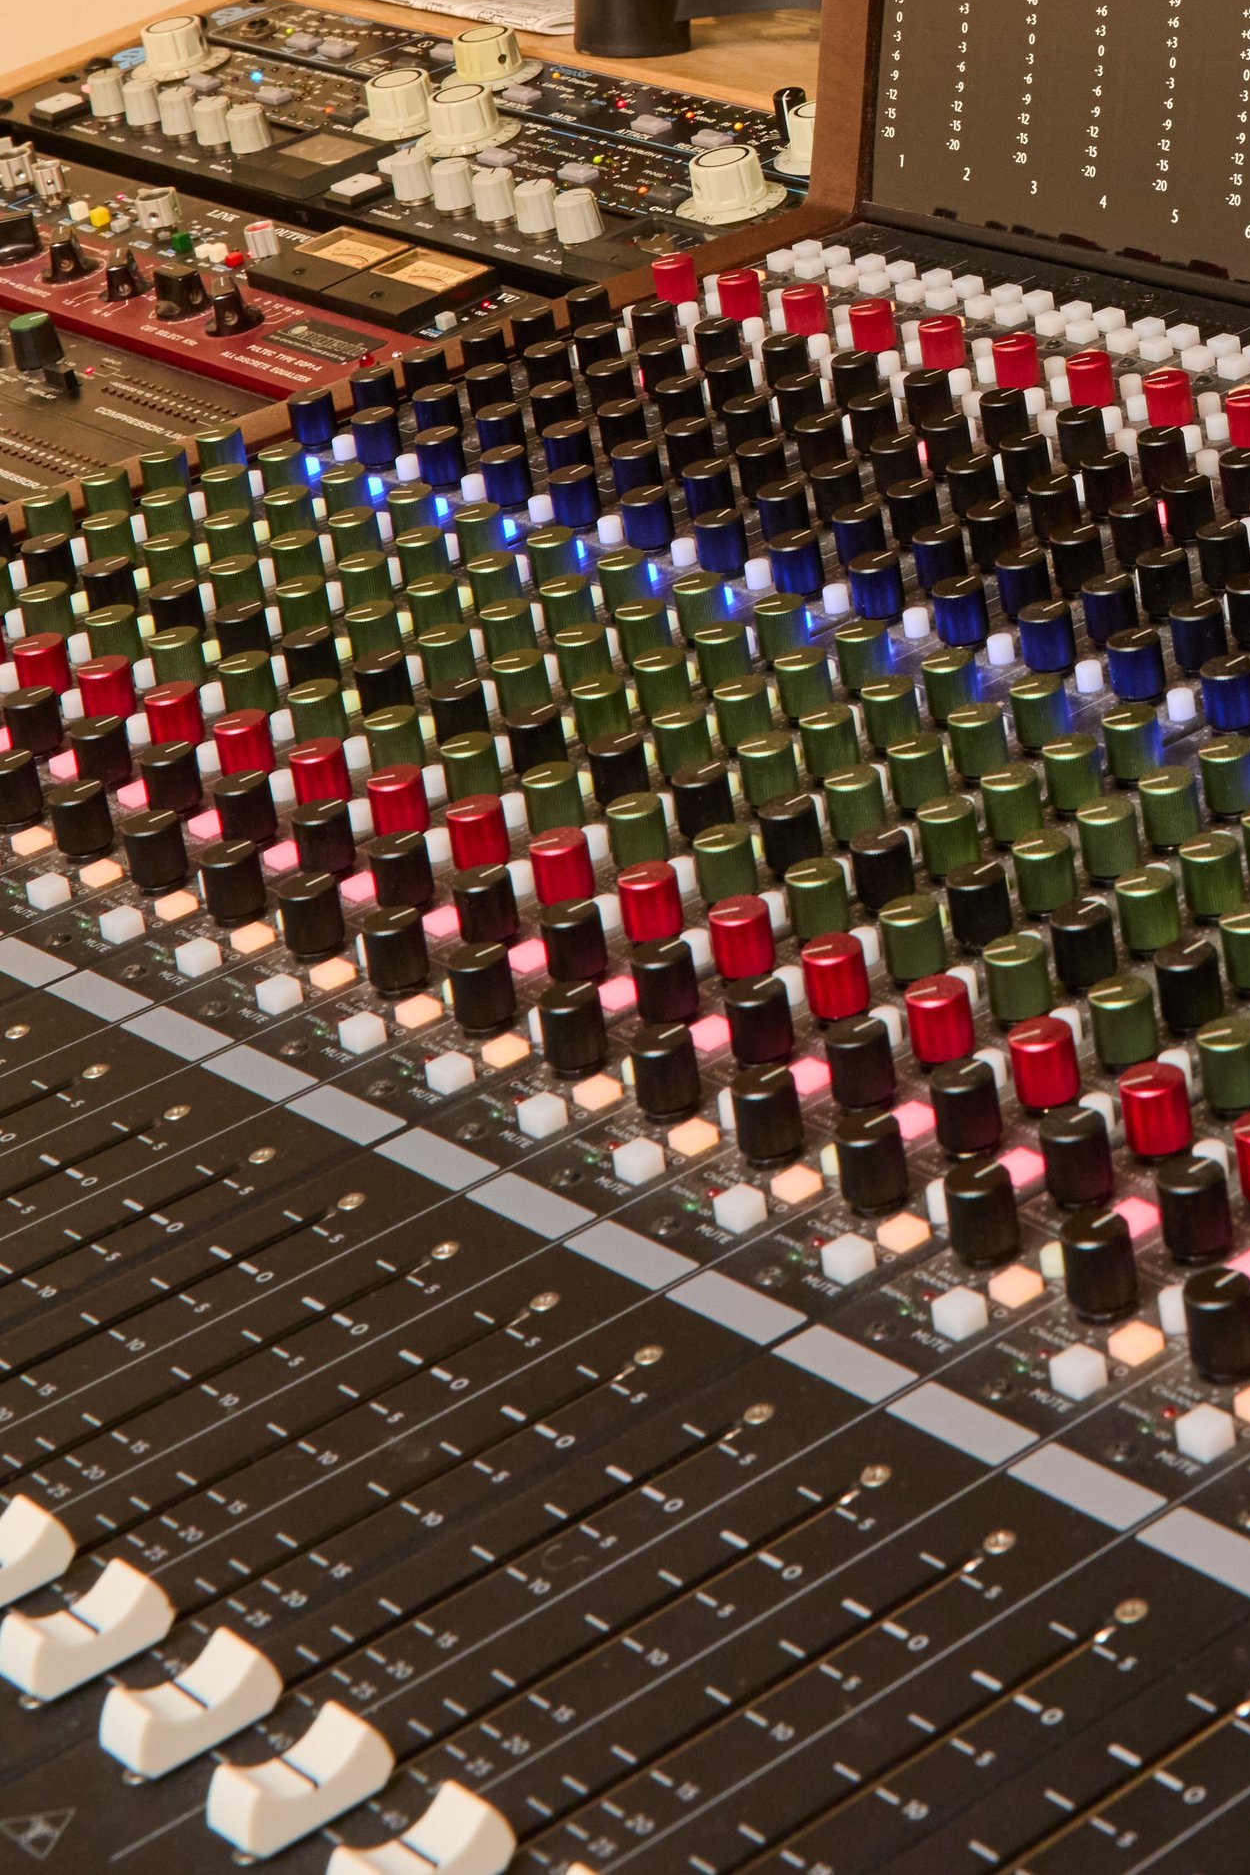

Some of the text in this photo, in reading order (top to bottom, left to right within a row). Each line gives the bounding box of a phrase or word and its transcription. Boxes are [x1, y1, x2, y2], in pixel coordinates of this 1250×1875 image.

[1025, 13, 1038, 26] +3
[1028, 32, 1036, 46] 0
[1024, 52, 1035, 65] -3
[1023, 72, 1033, 85] -6
[1021, 93, 1032, 105] -9
[1017, 112, 1031, 126] -12
[615, 129, 653, 141] ATTACK
[1015, 132, 1029, 145] -15
[899, 153, 905, 168] 1
[1012, 151, 1028, 165] -20
[962, 166, 971, 182] 2
[1030, 180, 1038, 195] 3
[1099, 194, 1108, 209] 4
[206, 209, 240, 222] LINK
[1170, 208, 1179, 224] 5
[452, 232, 478, 242] ATTACK
[497, 293, 520, 303] VU
[155, 330, 185, 342] SELECT
[246, 344, 276, 357] PULTEC
[275, 353, 296, 365] TYPE
[220, 351, 311, 383] ALL-DISCRETE EQUALIZER
[8, 904, 38, 920] MUTE
[160, 969, 188, 988] MUTE
[237, 1007, 269, 1024] MUTE
[320, 1046, 353, 1064] MUTE
[408, 1087, 443, 1105] MUTE
[70, 1099, 84, 1108] 5
[499, 1129, 534, 1148] MUTE
[153, 1141, 168, 1151] 5
[80, 1176, 98, 1186] 0
[594, 1175, 632, 1196] MUTE
[238, 1186, 255, 1195] 5
[166, 1222, 185, 1233] 0
[696, 1224, 734, 1244] MUTE
[105, 1251, 122, 1262] 5
[255, 1271, 274, 1283] 0
[801, 1274, 843, 1297] MUTE
[194, 1303, 211, 1313] 5
[350, 1322, 369, 1336] 0
[911, 1329, 953, 1353] MUTE
[449, 1377, 470, 1391] 0
[1029, 1388, 1075, 1413] MUTE
[555, 1435, 576, 1449] 0
[1154, 1449, 1200, 1476] MUTE
[662, 1496, 685, 1513] 0
[780, 1564, 803, 1581] 0
[907, 1633, 931, 1652] 0
[1041, 1706, 1065, 1725] 0
